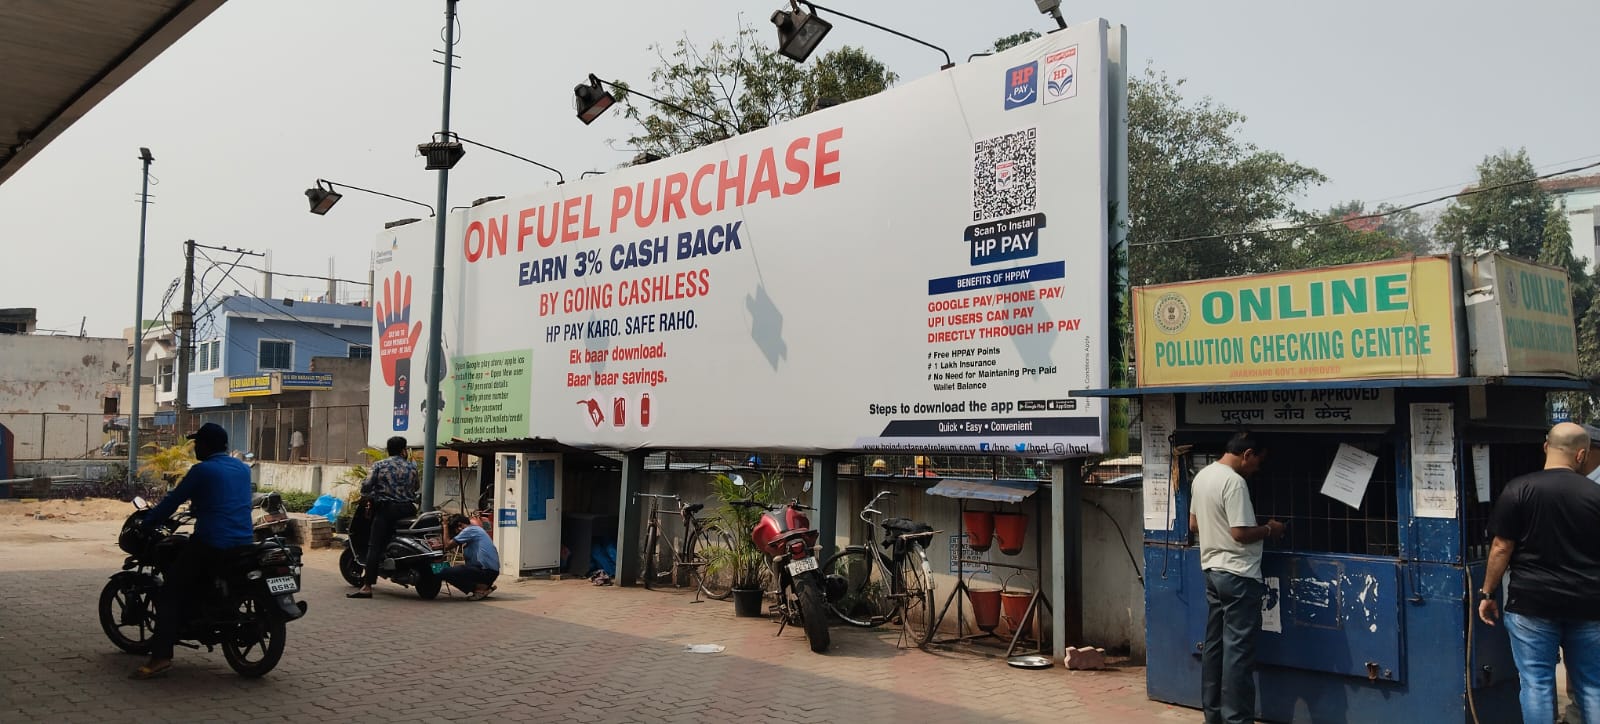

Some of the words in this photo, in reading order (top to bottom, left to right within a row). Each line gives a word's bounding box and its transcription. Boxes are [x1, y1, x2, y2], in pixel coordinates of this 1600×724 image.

[1012, 66, 1034, 86] HP
[1054, 68, 1067, 80] HP
[1014, 84, 1028, 96] PAY
[464, 214, 508, 262] ON
[517, 194, 600, 252] FUEL
[609, 127, 844, 233] PURCHASE
[974, 226, 994, 237] Scan
[997, 224, 1007, 232] To
[1009, 218, 1036, 230] Install
[518, 254, 567, 287] EARN
[574, 248, 602, 278] 3%
[610, 236, 668, 271] CASH
[677, 220, 744, 260] BACK
[974, 238, 996, 258] HP
[1002, 232, 1034, 254] PAY
[958, 275, 991, 288] BENEFITS
[993, 274, 1003, 284] OF
[1005, 269, 1030, 282] HPPAY
[540, 292, 559, 316] BY
[564, 283, 612, 314] GOING
[618, 268, 710, 307] CASHLESS
[928, 298, 970, 312] GOOGLE
[973, 290, 1036, 307] PAY/PHONE
[1040, 286, 1065, 300] PAY/
[1200, 273, 1410, 325] ONLINE
[1520, 270, 1569, 316] ONLINE
[546, 325, 560, 342] HP
[564, 322, 584, 341] PAY
[588, 318, 621, 339] KARO.
[626, 314, 656, 336] SAFE
[660, 310, 698, 332] RAHO.
[928, 317, 944, 328] UPI
[948, 312, 982, 326] USERS
[986, 309, 1009, 322] CAN
[1014, 307, 1034, 319] PAY
[928, 330, 976, 343] DIRECTLY
[980, 324, 1034, 338] THROUGH
[1038, 322, 1054, 334] HP
[1058, 319, 1081, 331] PAY
[570, 349, 582, 364] Ek
[585, 348, 608, 364] baar
[612, 342, 666, 362] download.
[934, 351, 950, 359] Free
[952, 349, 976, 358] HPPAY
[978, 347, 1000, 356] Points
[1155, 336, 1244, 368] POLLUTION
[1250, 329, 1344, 364] CHECKING
[1350, 324, 1432, 358] CENTRE
[466, 361, 480, 370] Google
[505, 357, 516, 366] apple
[940, 361, 958, 369] Lakh
[960, 359, 996, 368] Insurance
[945, 372, 963, 380] Need
[966, 371, 976, 379] for
[1022, 367, 1036, 375] Pre
[1039, 366, 1057, 374] Paid
[1298, 366, 1341, 375] APPROVED
[568, 372, 591, 387] Baar
[594, 371, 618, 386] baar
[622, 368, 668, 386] savings.
[934, 383, 954, 391] Wallet
[957, 382, 987, 390] Balance
[492, 392, 509, 400] number
[1198, 391, 1268, 405] JHARKHAND
[1272, 390, 1306, 402] GOVT.
[1311, 388, 1380, 402] APPROVED
[470, 404, 481, 412] Enter
[482, 403, 502, 413] password
[869, 403, 897, 416] Steps
[900, 403, 910, 414] to
[914, 401, 965, 414] download
[969, 401, 988, 413] the
[991, 402, 1013, 414] app
[1274, 403, 1304, 420] जाँच
[1314, 403, 1352, 421] केन्द्र
[938, 422, 958, 432] Quick
[966, 422, 982, 434] Easy
[991, 420, 1032, 431] Convenient
